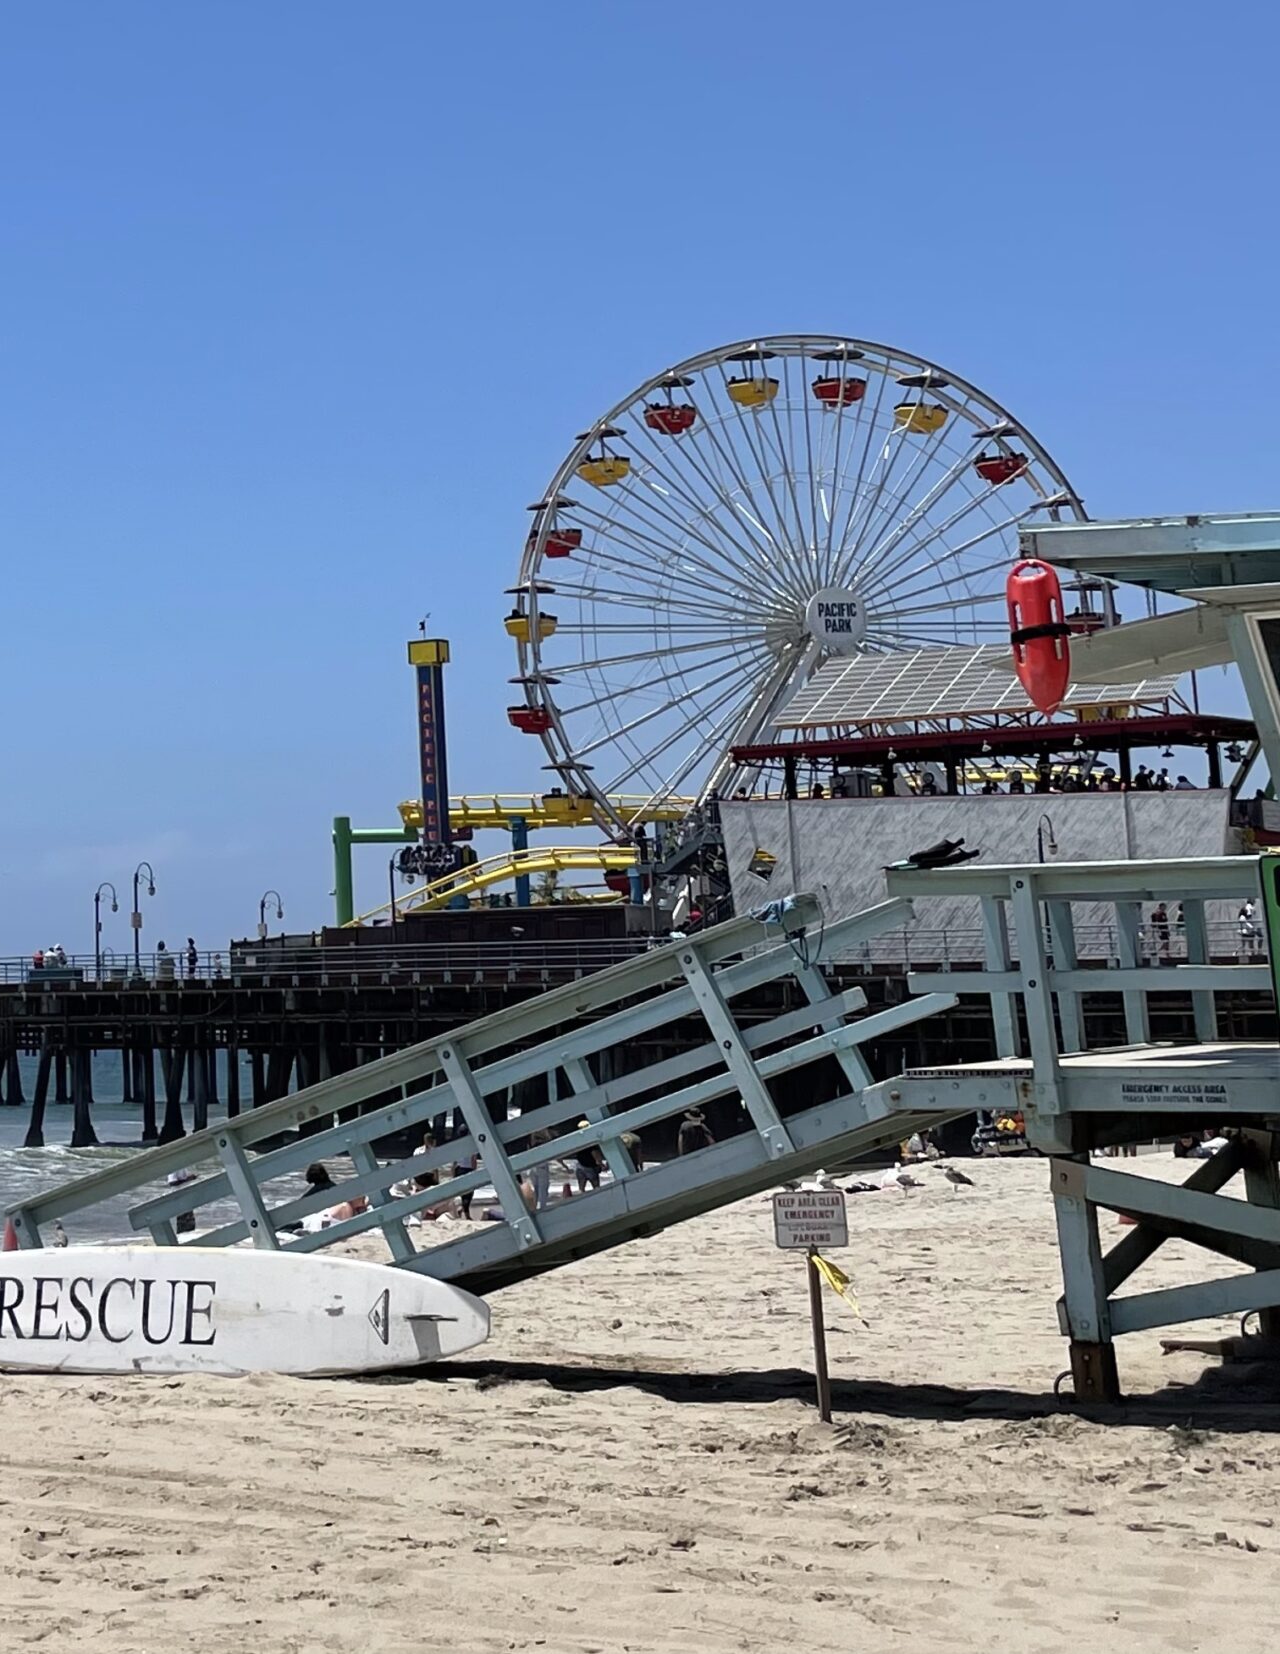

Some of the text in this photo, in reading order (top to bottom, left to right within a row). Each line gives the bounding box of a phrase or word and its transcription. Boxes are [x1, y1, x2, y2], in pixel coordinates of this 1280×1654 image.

[817, 602, 857, 618] PACIFIC
[825, 618, 852, 633] PARK
[422, 683, 434, 784] PACIFIC
[1122, 1084, 1226, 1094] EMERGENCY ACCESS AREA
[778, 1196, 840, 1207] KEEP AREA CLEAR
[784, 1210, 834, 1219] EMERGENCY
[793, 1233, 831, 1243] PARKING
